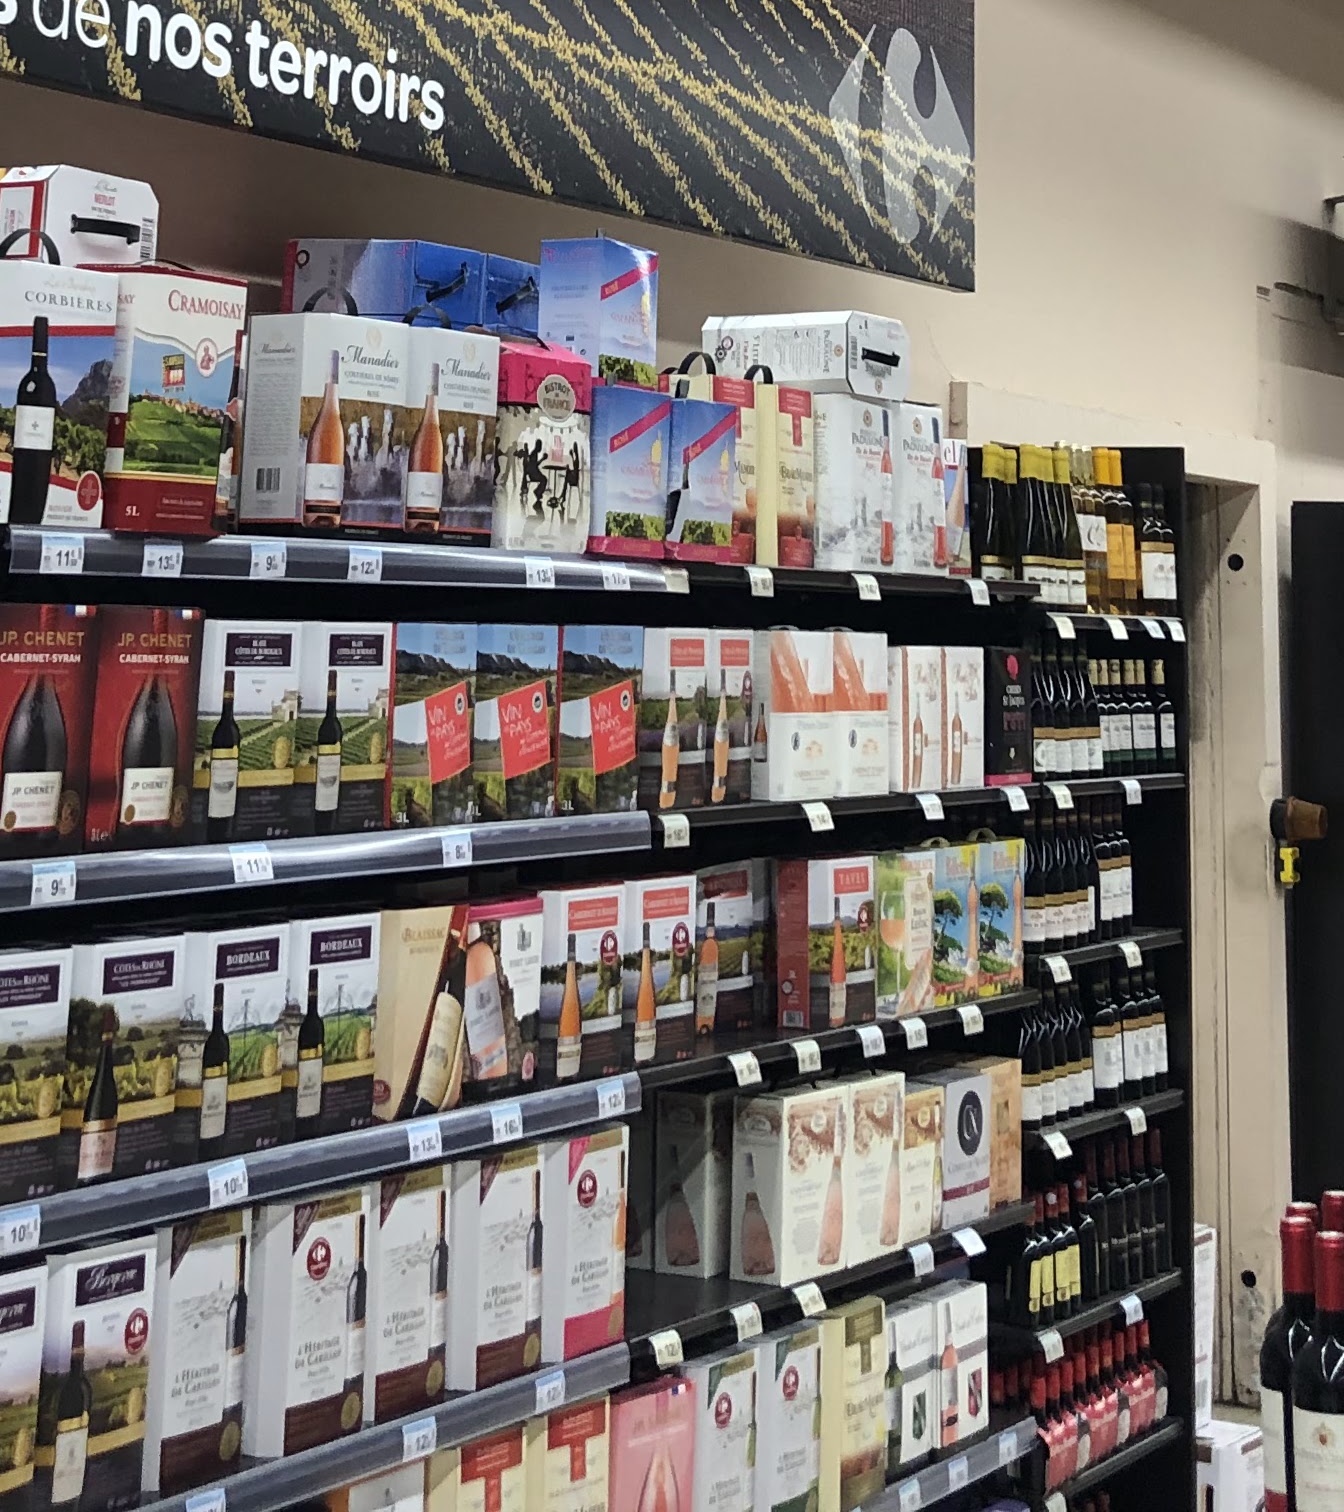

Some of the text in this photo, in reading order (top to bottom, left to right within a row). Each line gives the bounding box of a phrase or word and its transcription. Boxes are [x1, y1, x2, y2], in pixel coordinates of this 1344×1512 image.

[125, 3, 234, 78] nos
[247, 20, 446, 131] terroirs
[167, 289, 245, 320] CRAMOISAY
[341, 344, 399, 369] Manadier
[441, 357, 492, 381] Manadier
[125, 505, 140, 517] 5L
[24, 630, 86, 648] CHENET
[140, 634, 193, 649] CHENET
[502, 702, 523, 724] VIN
[593, 702, 612, 722] VIN
[510, 716, 532, 736] PAYS
[320, 936, 363, 954] BORDEAUX
[226, 949, 271, 966] BORDEAUX
